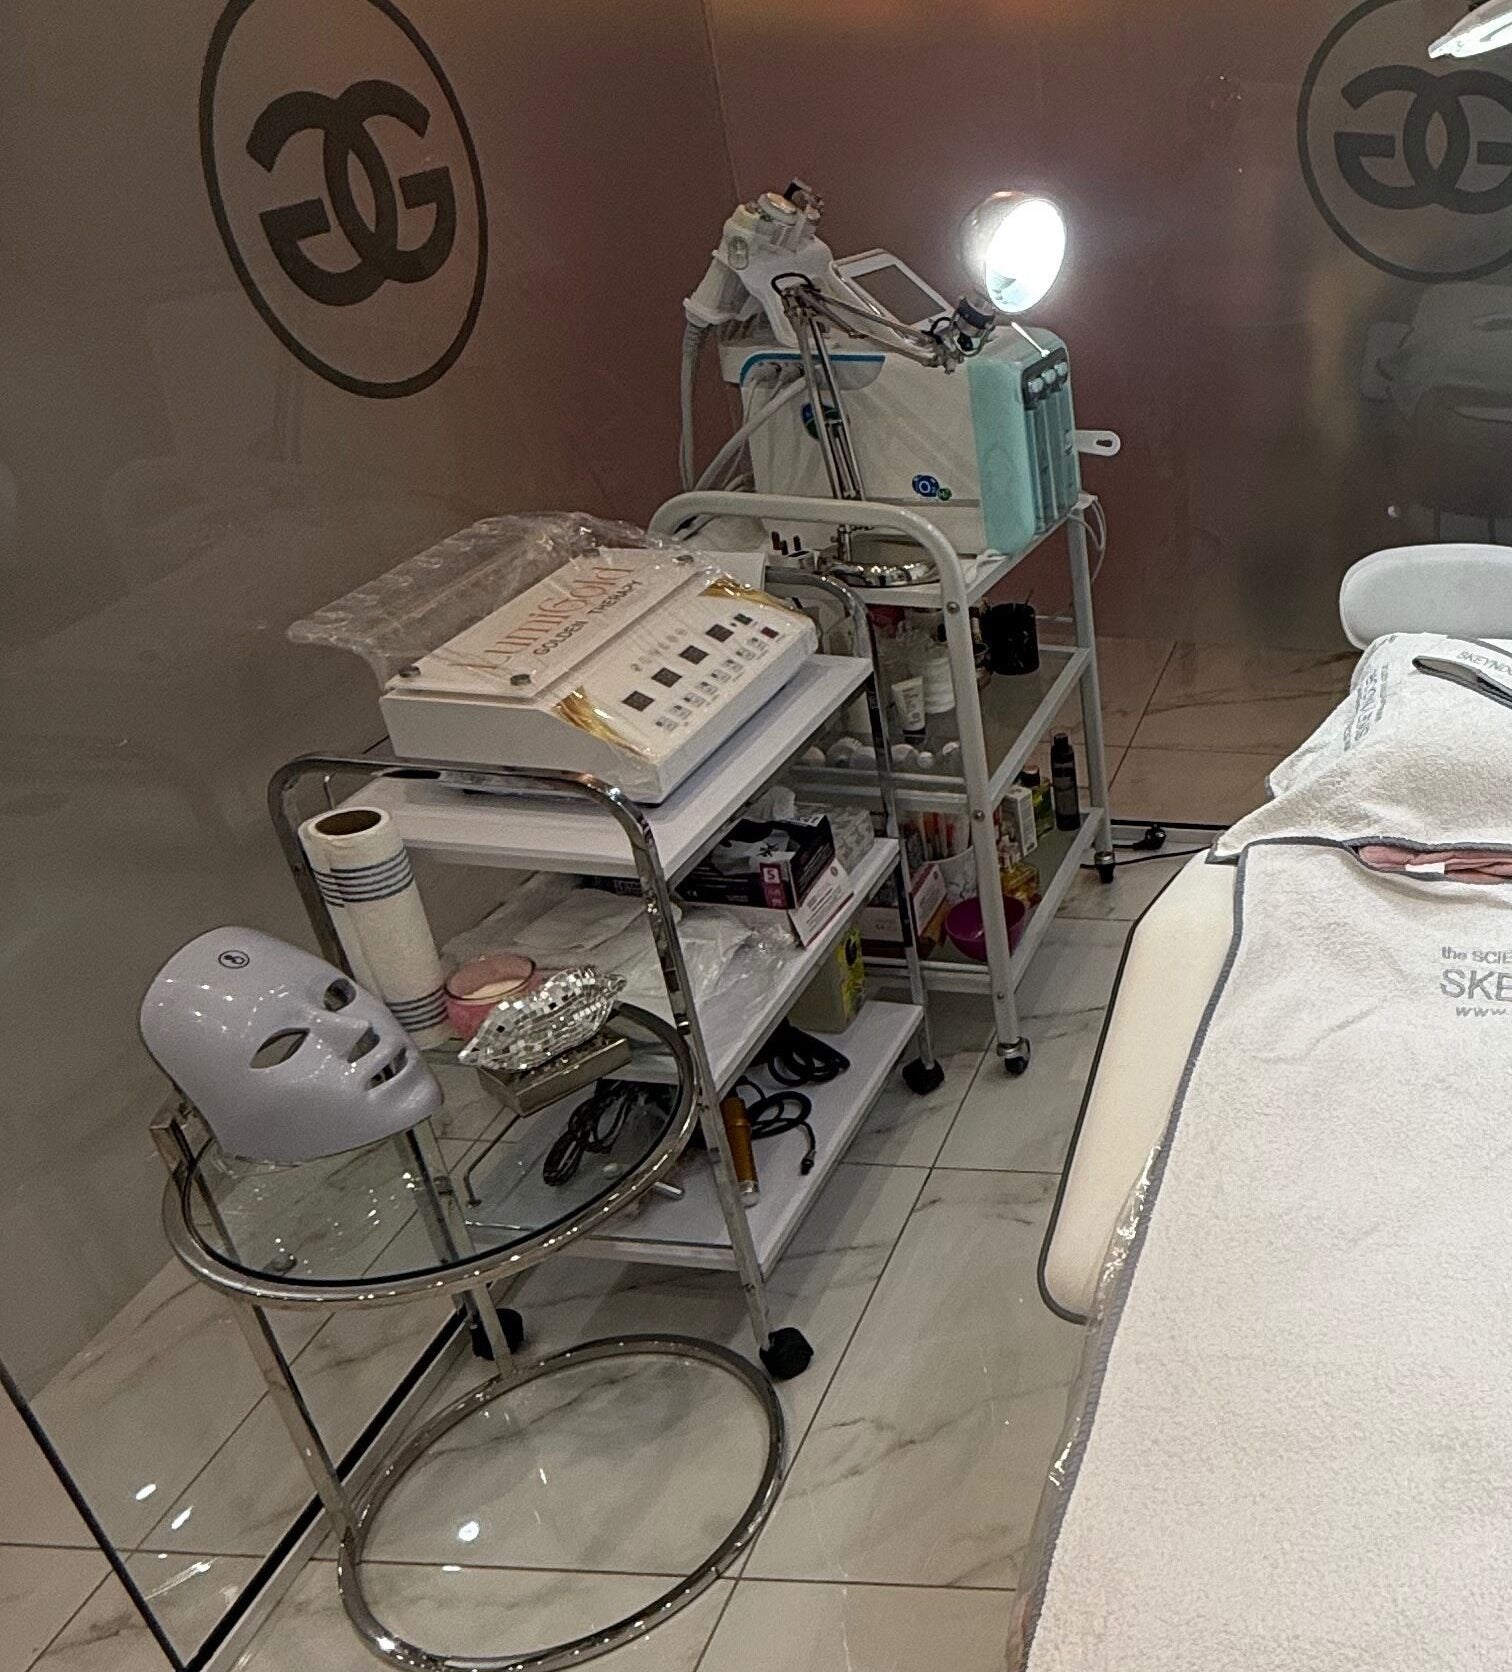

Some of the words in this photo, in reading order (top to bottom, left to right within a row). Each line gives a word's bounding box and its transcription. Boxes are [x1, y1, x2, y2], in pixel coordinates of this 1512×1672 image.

[533, 620, 590, 656] GOLDEN
[588, 580, 644, 615] THERAPY
[1441, 946, 1467, 960] the
